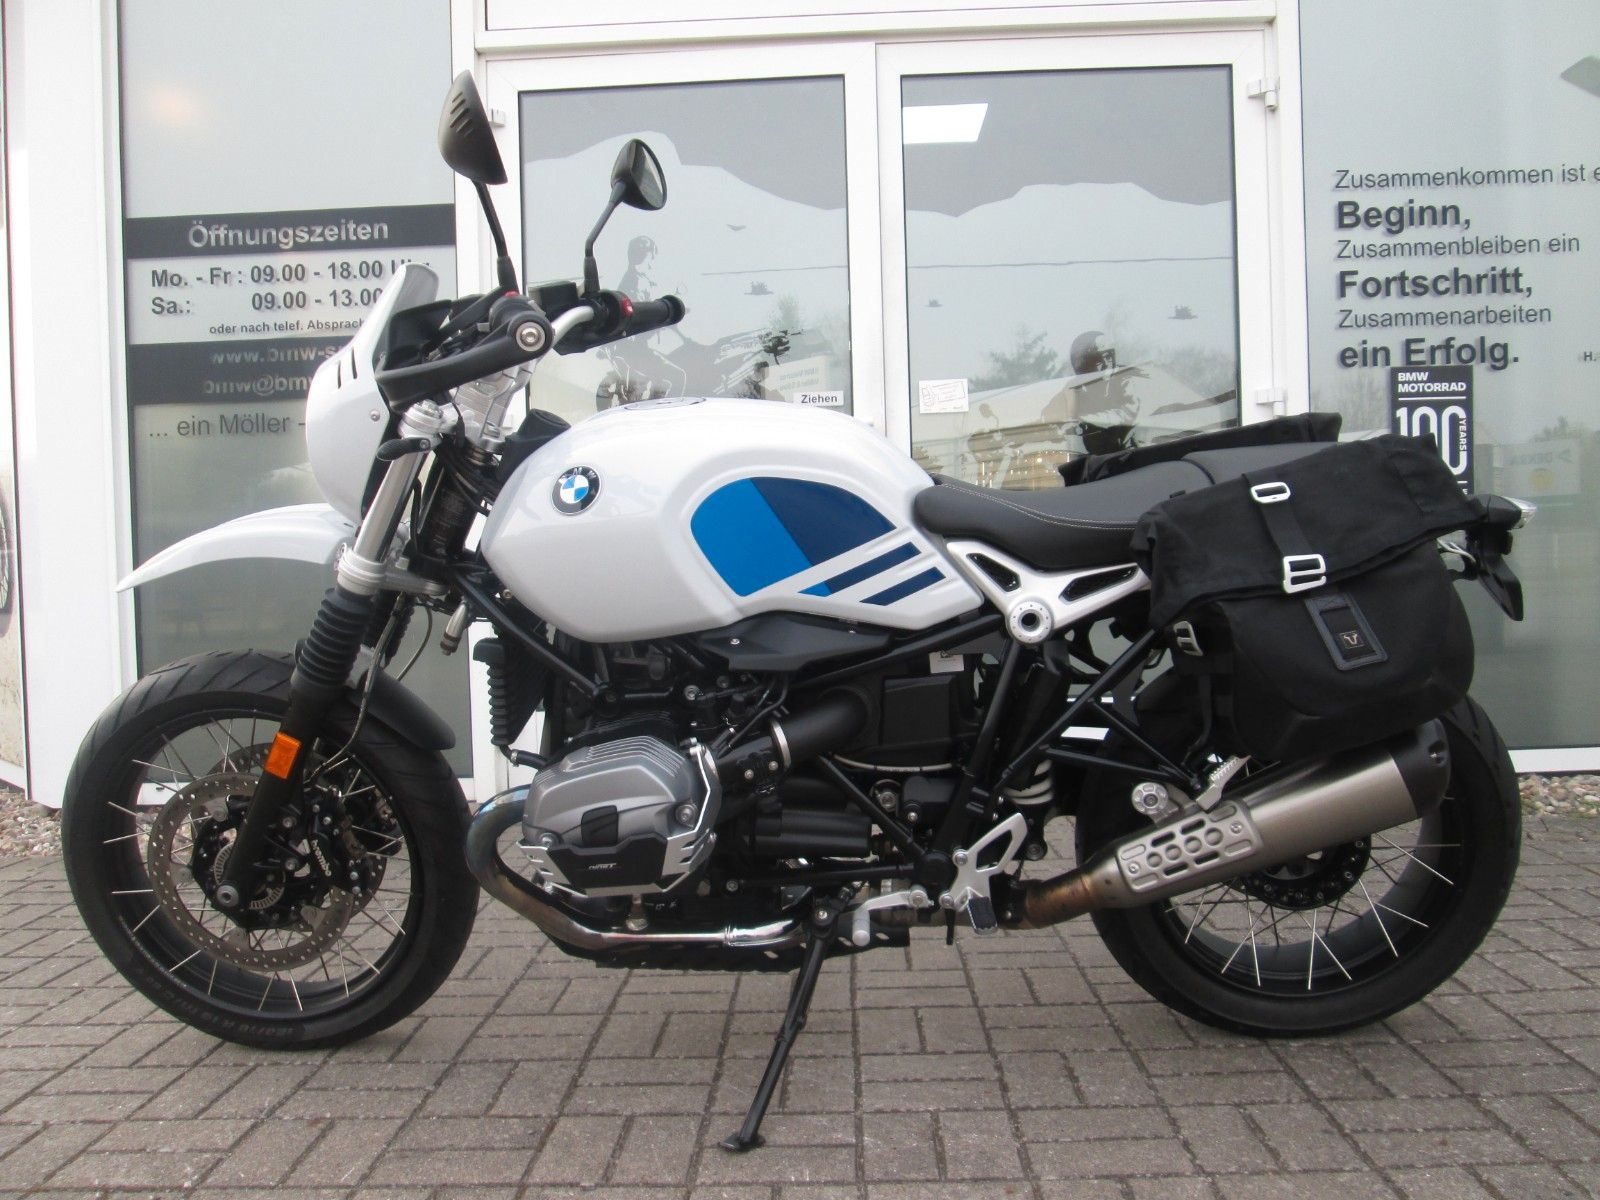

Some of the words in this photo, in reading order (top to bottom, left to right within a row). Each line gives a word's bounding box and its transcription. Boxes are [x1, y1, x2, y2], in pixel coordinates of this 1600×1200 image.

[1335, 166, 1553, 188] Zusammenkommen
[1562, 163, 1586, 182] ist
[1337, 198, 1471, 234] Beginn,
[189, 218, 389, 250] Öffnungszeiten
[1337, 236, 1540, 258] Zusammenbleiben
[1549, 233, 1580, 252] ein
[151, 269, 188, 287] Mo.
[250, 264, 306, 283] 09.00
[328, 260, 383, 279] 18.00
[1338, 266, 1532, 298] Fortschritt,
[251, 291, 307, 310] 09.00
[209, 323, 237, 334] oder
[240, 321, 270, 333] nach
[274, 320, 303, 331] telef.
[1338, 305, 1551, 328] Zusammenarbeiten
[1340, 339, 1391, 368] ein
[1405, 336, 1519, 370] Erfolg.
[1397, 372, 1429, 381] BMW
[1397, 382, 1467, 392] MOTORRAD
[801, 394, 838, 404] Ziehen
[177, 415, 210, 436] ein
[219, 413, 290, 435] Möller
[1459, 417, 1467, 451] YEARS
